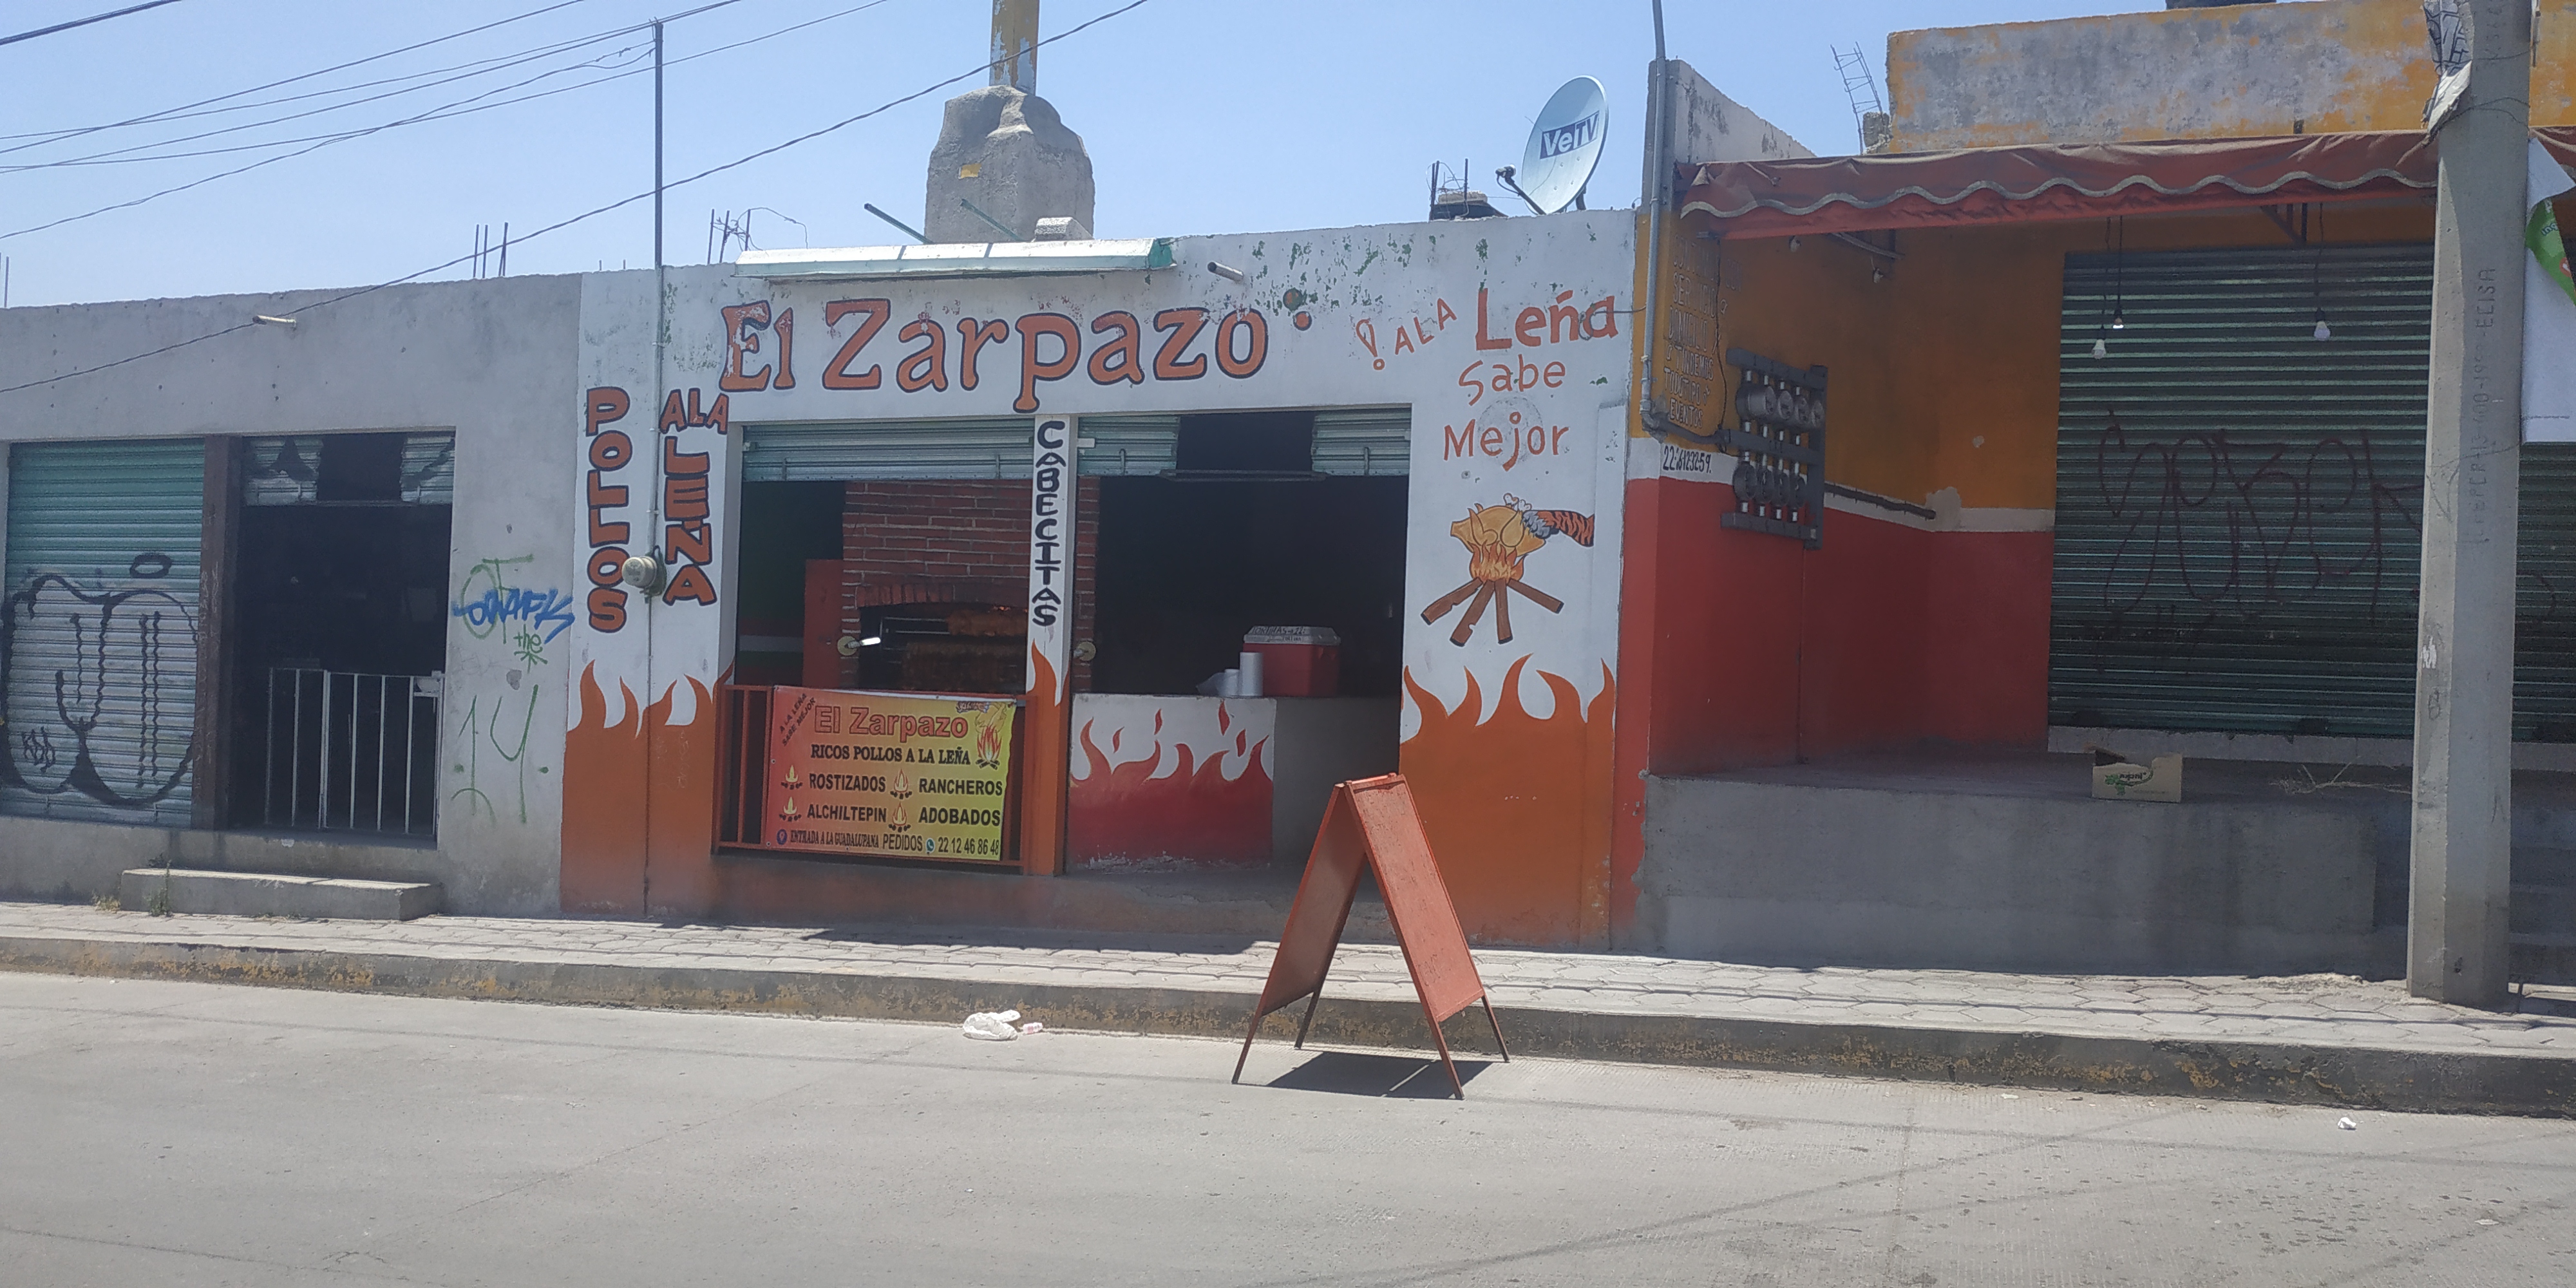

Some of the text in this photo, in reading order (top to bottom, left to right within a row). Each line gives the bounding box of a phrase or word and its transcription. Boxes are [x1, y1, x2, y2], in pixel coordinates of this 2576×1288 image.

[719, 298, 1268, 413] El Zarpazo
[1459, 354, 1566, 406] Sabe
[1670, 397, 1703, 428] EVENTOS
[1444, 412, 1569, 471] Mejor
[585, 386, 632, 633] POLLOS
[663, 436, 717, 606] LEÑA
[1032, 421, 1066, 627] CABECITAS
[782, 697, 816, 746] SABE MEJOR
[784, 714, 792, 725] LA
[791, 693, 807, 715] LEÑA
[815, 705, 969, 743] El Zarpazo
[811, 744, 971, 765] RICOS POLLOS A LA LEÑA
[809, 773, 886, 792] ROSTIZADOS
[919, 778, 1003, 796] RANCHEROS
[807, 804, 887, 822] ALCHILTEPIN
[918, 807, 1000, 826] ADOBADOS
[790, 829, 879, 848] ENTRADA A LA GUADALUPANA
[883, 834, 999, 856] PEDIDOS 22 12 46 86 48
